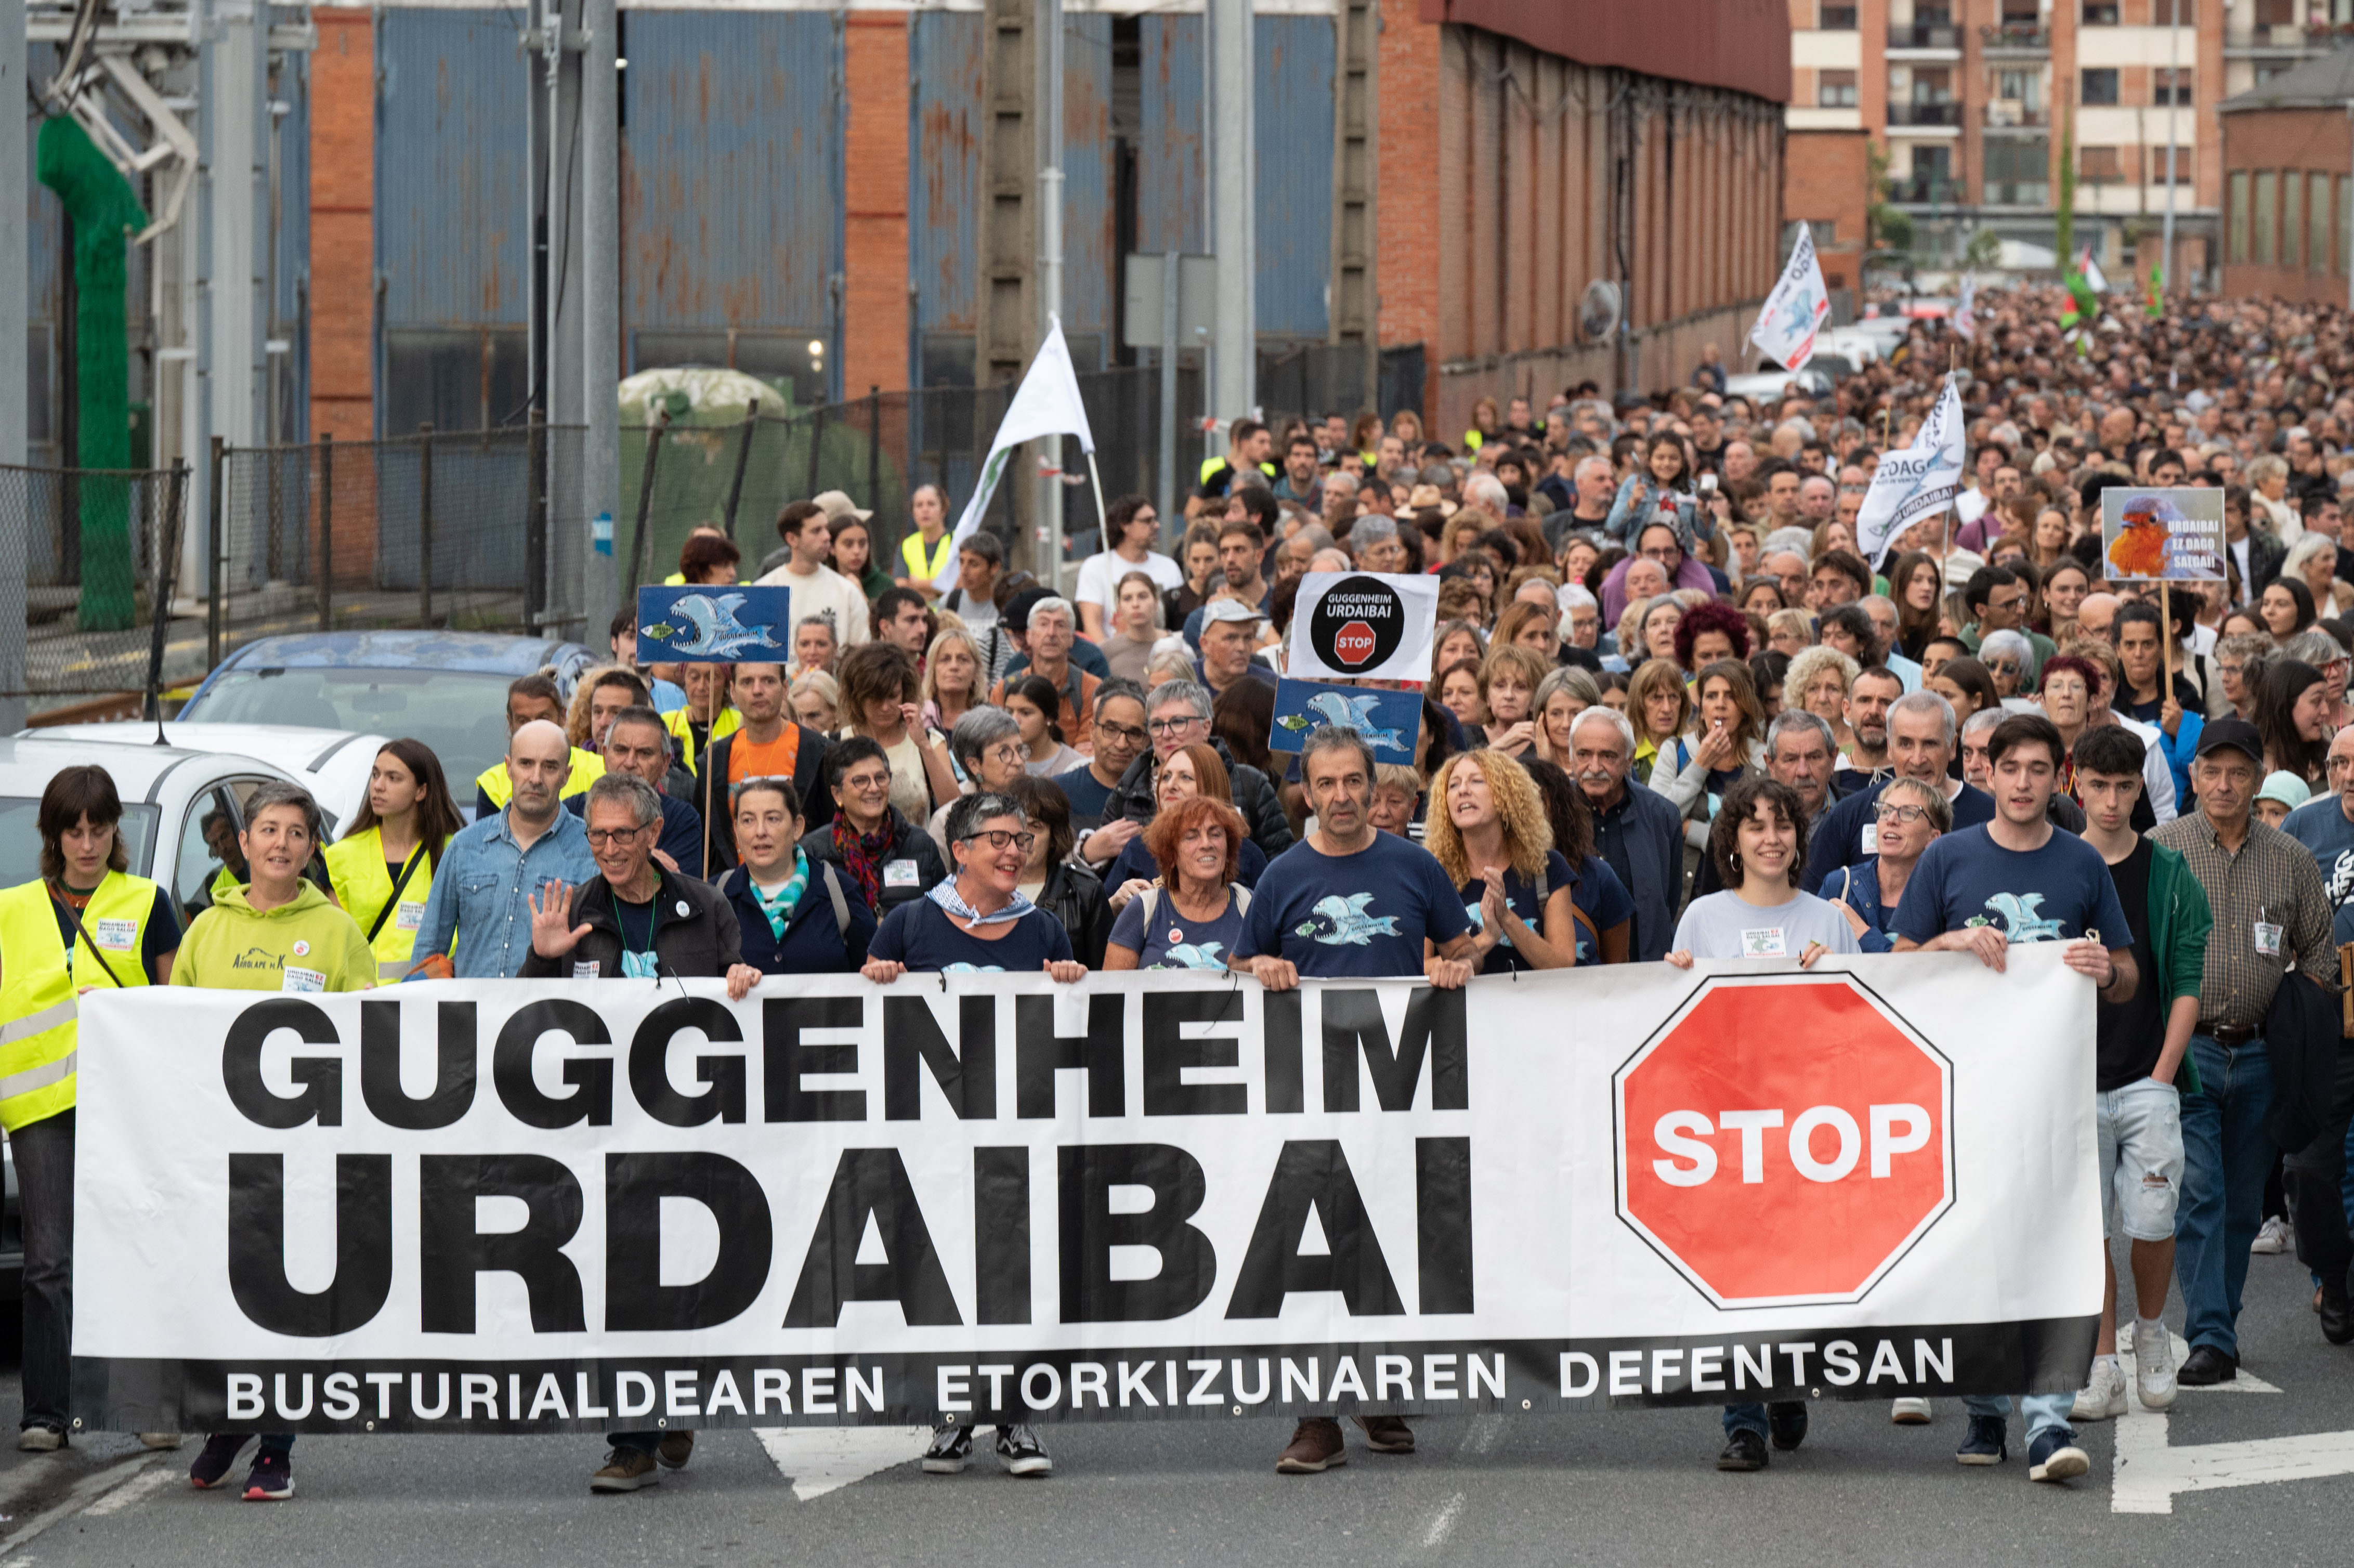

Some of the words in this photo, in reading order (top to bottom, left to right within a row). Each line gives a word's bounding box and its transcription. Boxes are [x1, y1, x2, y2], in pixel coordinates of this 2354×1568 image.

[2167, 520, 2219, 533] URDAIBAI
[2172, 538, 2184, 551] EZ
[2186, 538, 2215, 550] DAGO
[1328, 593, 1392, 604] GUGGENHEIM
[1327, 604, 1392, 618] URDAIBAI
[718, 631, 758, 641] GUGGENHEIM
[1339, 637, 1372, 649] STOP
[1352, 922, 1384, 931] GUGGENHEIM
[223, 987, 1469, 1130] GUGGENHEIM
[1652, 1103, 1932, 1188] STOP
[228, 1136, 1474, 1338] URDAIBAI
[227, 1366, 885, 1421] BUSTURIALDEAREN
[937, 1352, 1506, 1412] ETORKIZUNAREN
[1561, 1337, 1955, 1399] DEFENTSAN
